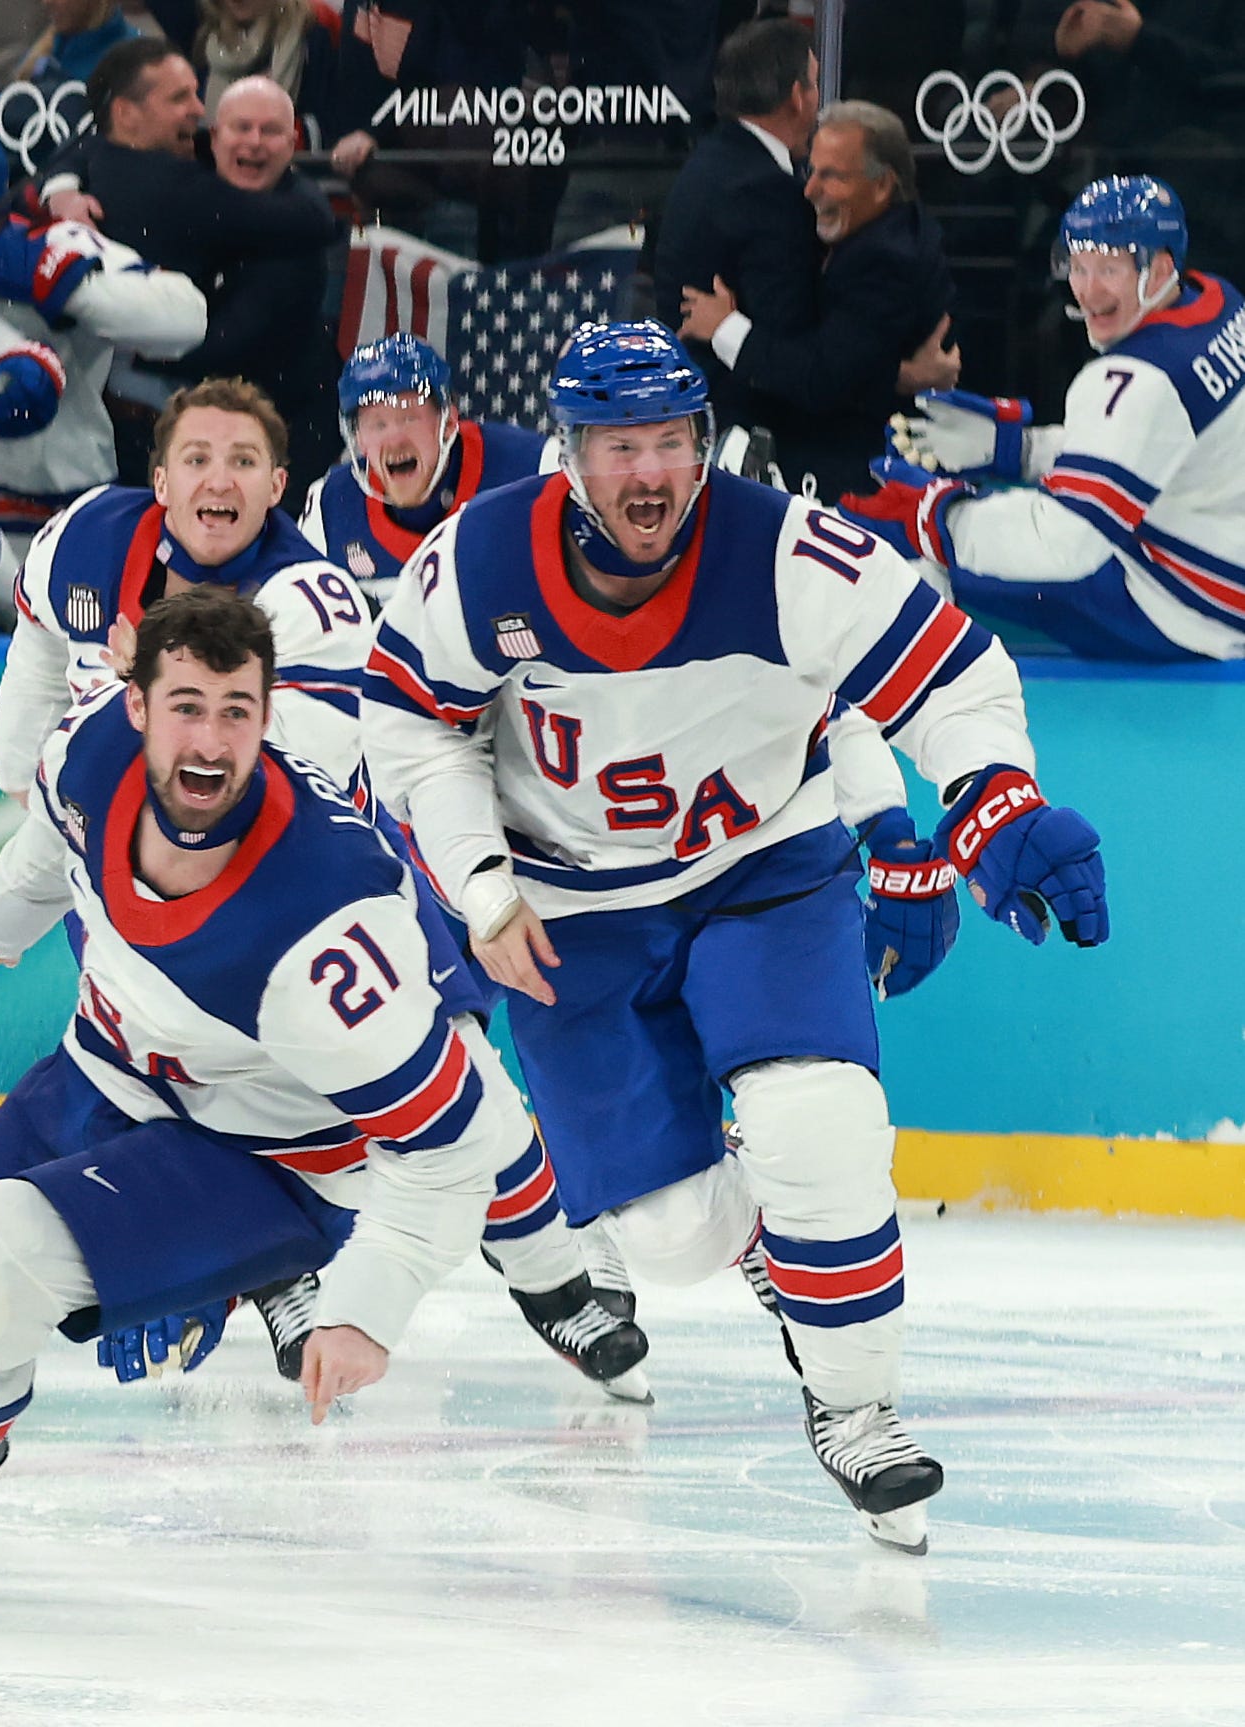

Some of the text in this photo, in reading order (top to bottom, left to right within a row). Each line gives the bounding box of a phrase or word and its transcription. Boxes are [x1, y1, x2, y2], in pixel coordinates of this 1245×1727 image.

[371, 84, 691, 127] MILANO CORTINA
[492, 126, 565, 167] 2026
[1104, 369, 1134, 418] 7
[792, 509, 877, 586] 10
[72, 586, 95, 601] USA
[292, 572, 362, 633] 19
[497, 615, 528, 632] USA
[520, 696, 761, 859] USA
[955, 783, 1040, 860] CCM
[310, 922, 401, 1030] 21
